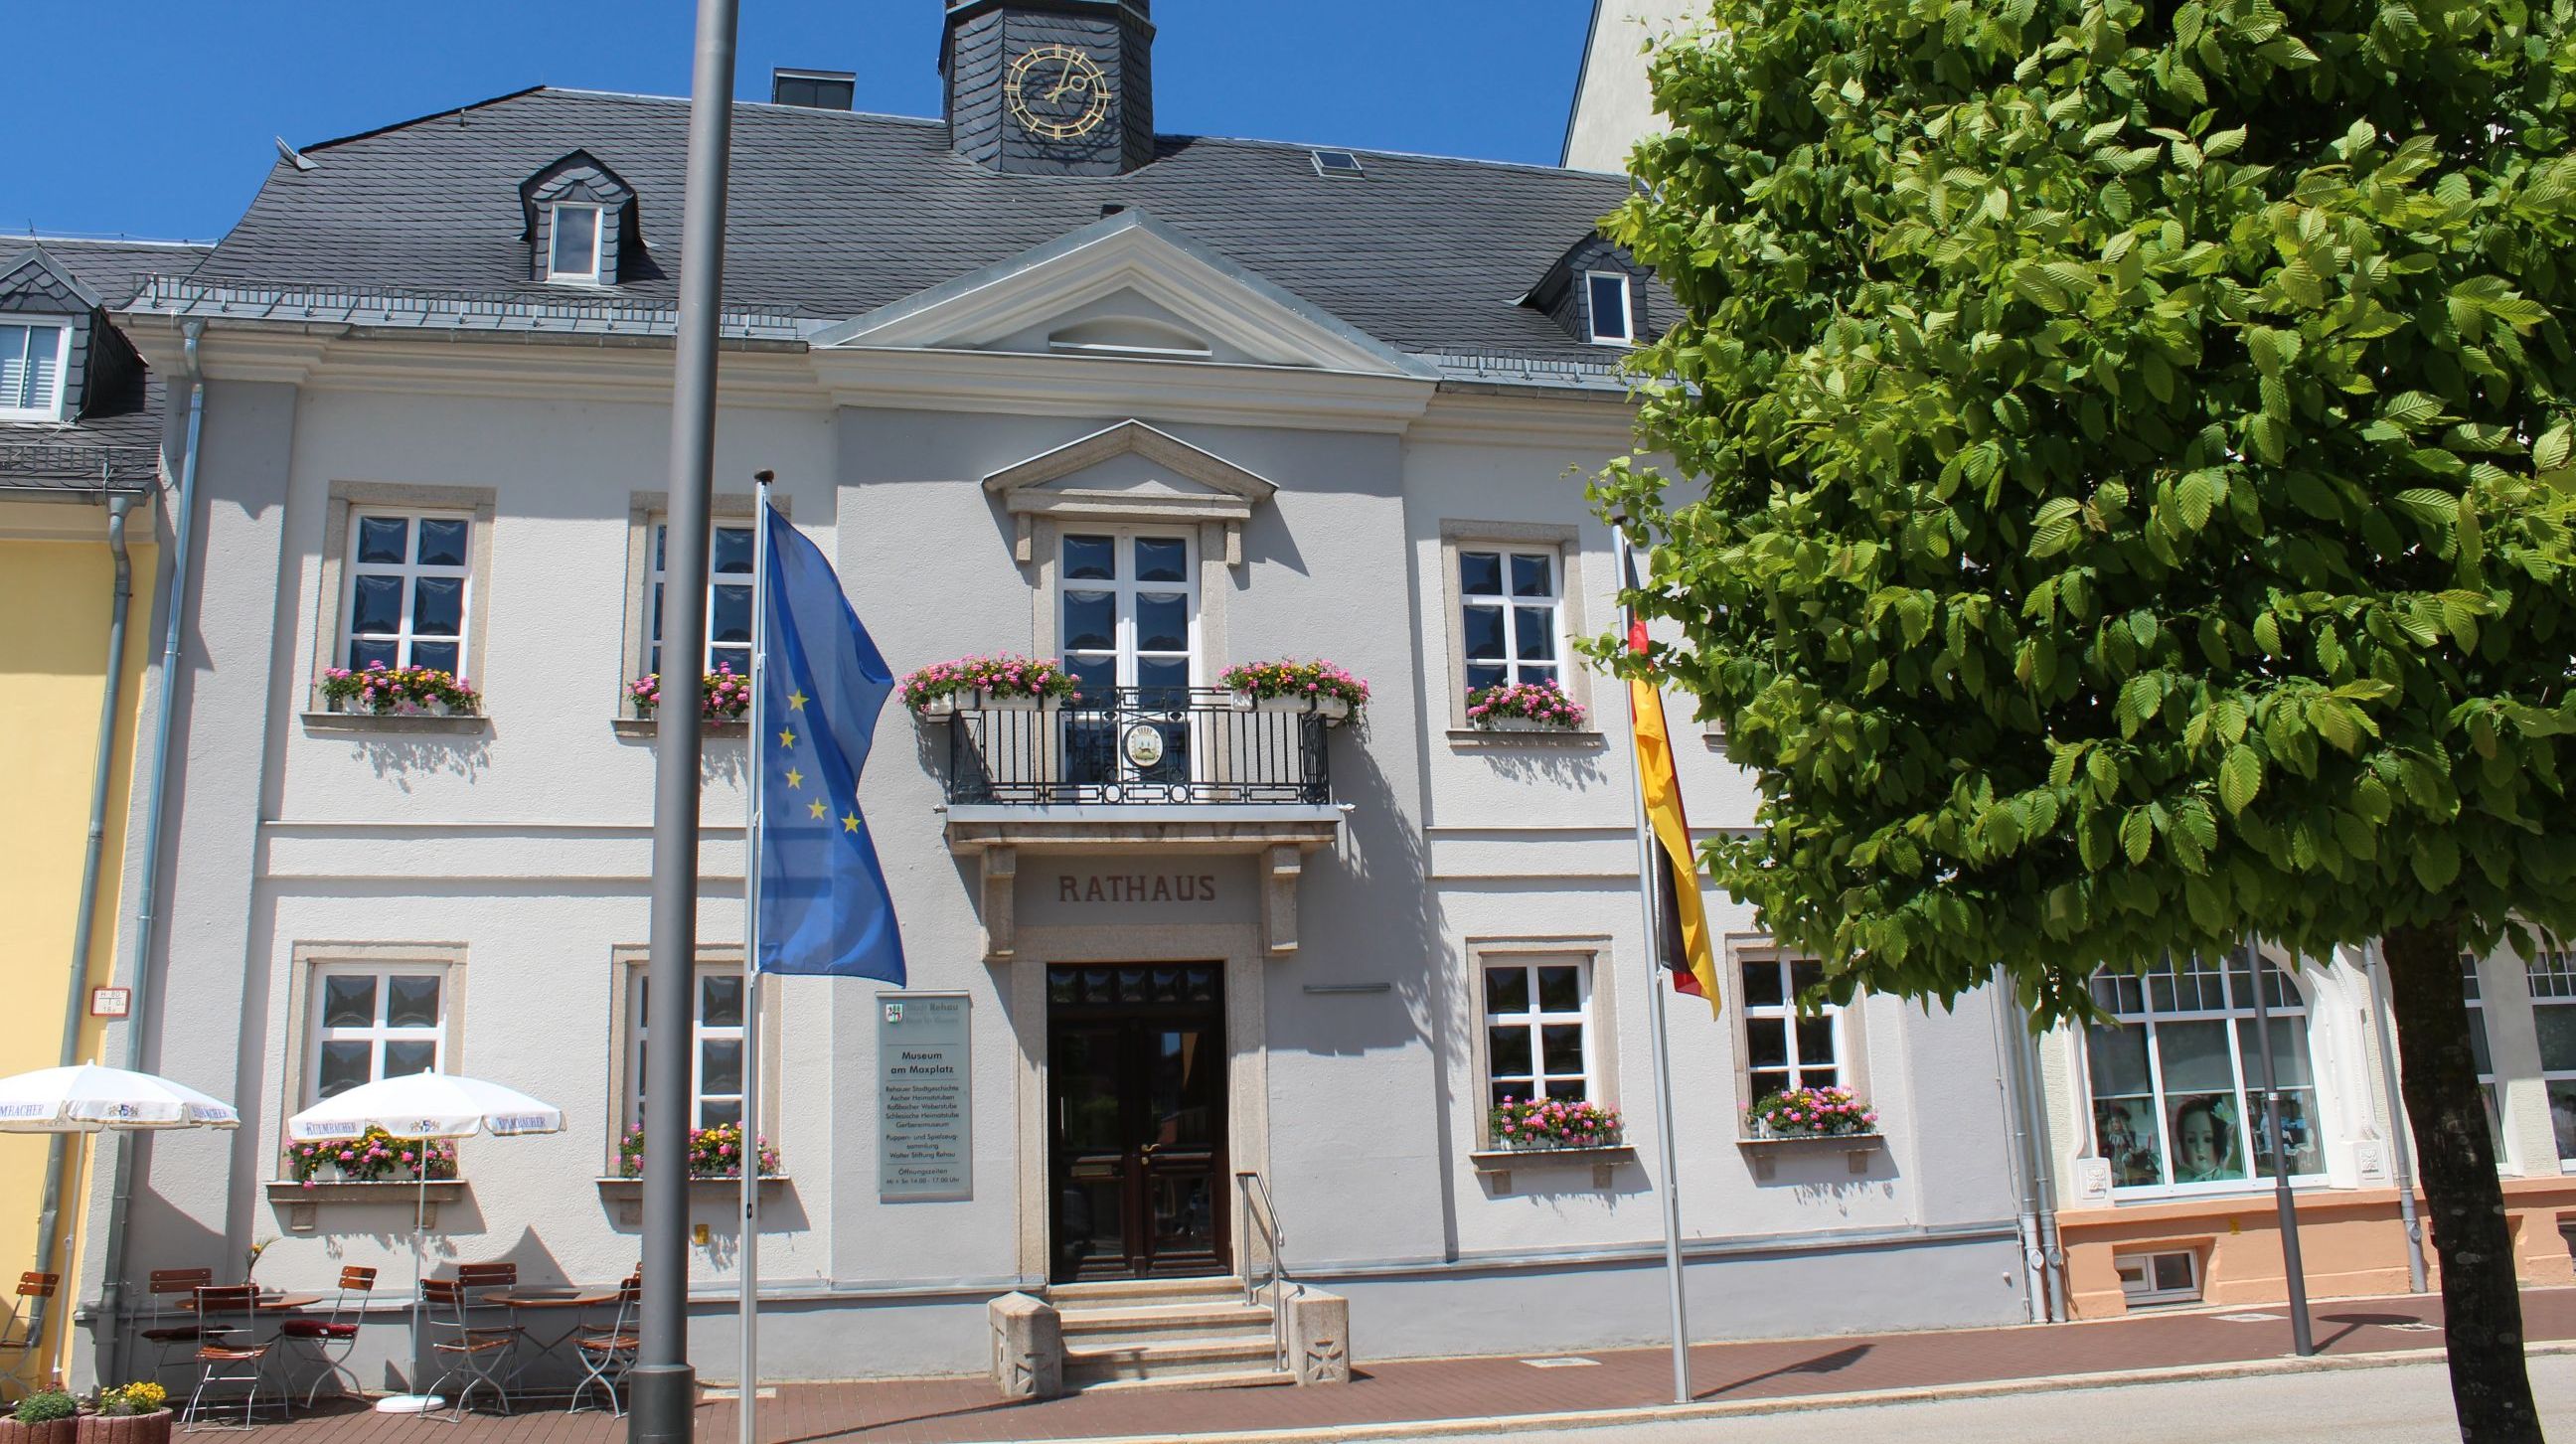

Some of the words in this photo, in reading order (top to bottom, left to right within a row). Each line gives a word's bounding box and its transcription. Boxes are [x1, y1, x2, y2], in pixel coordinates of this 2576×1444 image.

[1058, 876, 1215, 902] RATHAUS
[930, 1001, 959, 1011] Rehau
[901, 1051, 942, 1060] Museum
[909, 1064, 954, 1075] Maxplatz
[912, 1084, 959, 1093] Stadtgeschichte
[306, 1121, 358, 1135] KULMBACHER
[911, 1151, 934, 1160] Stiftung
[898, 1167, 948, 1176] Öffnungszeiten
